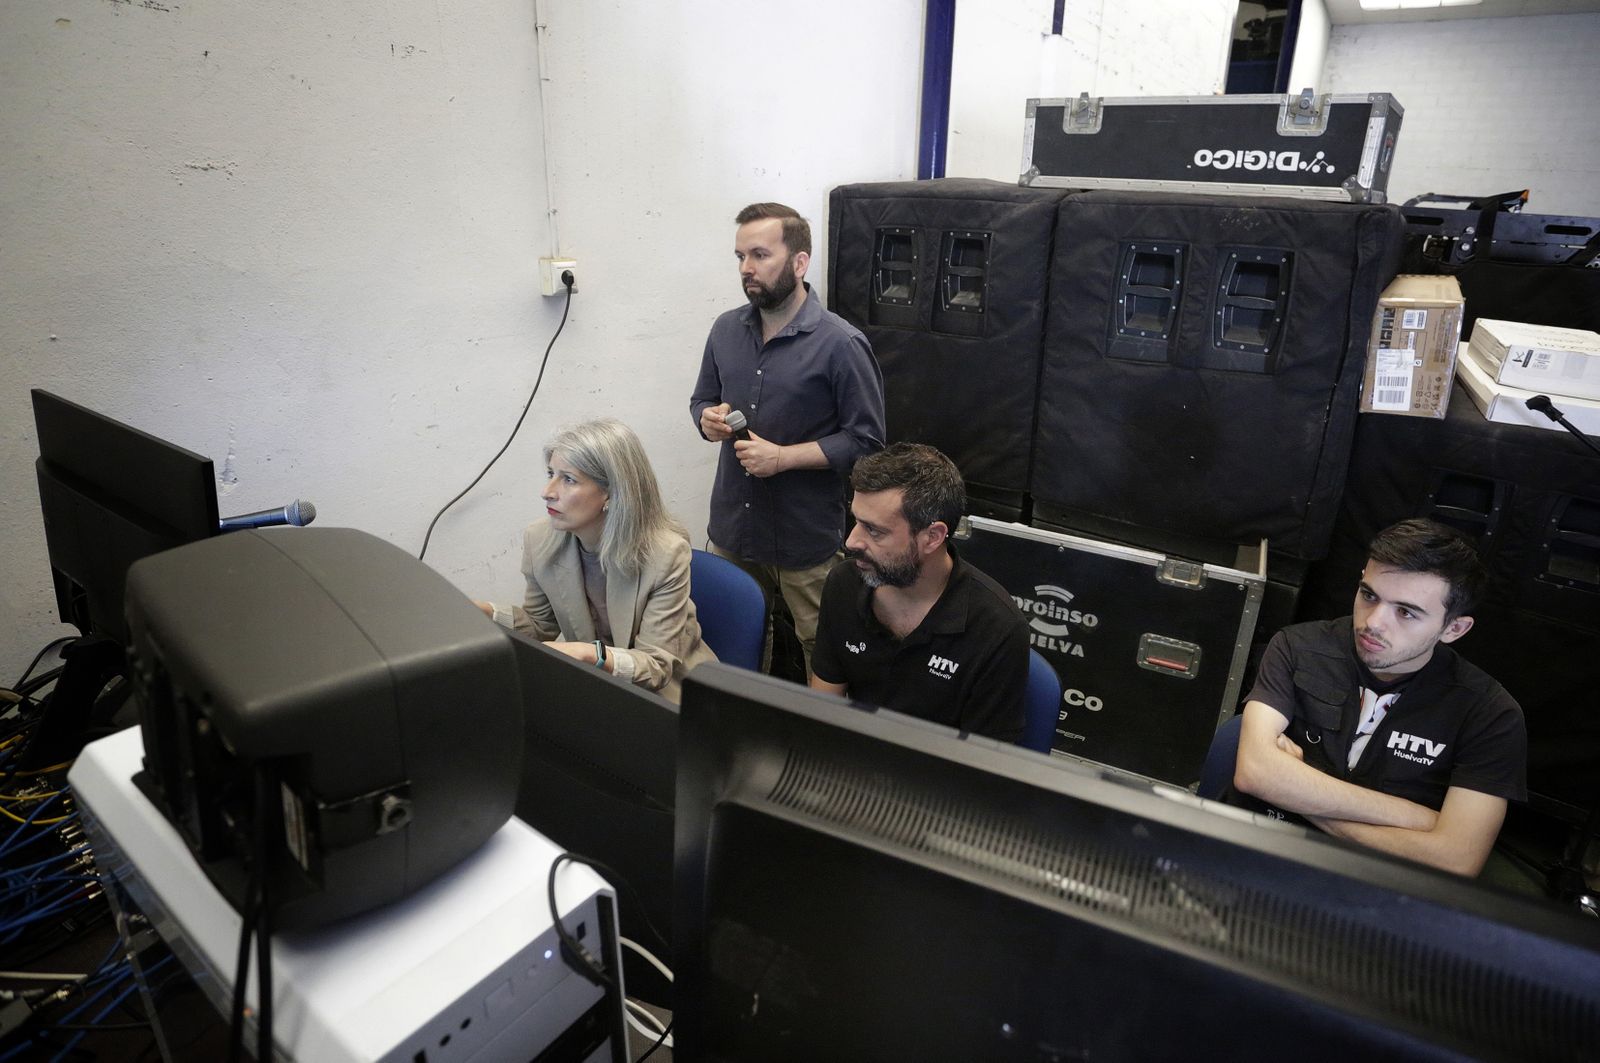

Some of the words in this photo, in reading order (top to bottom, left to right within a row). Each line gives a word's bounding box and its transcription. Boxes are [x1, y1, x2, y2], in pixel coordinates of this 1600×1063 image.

[927, 654, 959, 674] HTV
[1387, 730, 1447, 757] HTV
[1394, 749, 1434, 766] HuelvaTV
